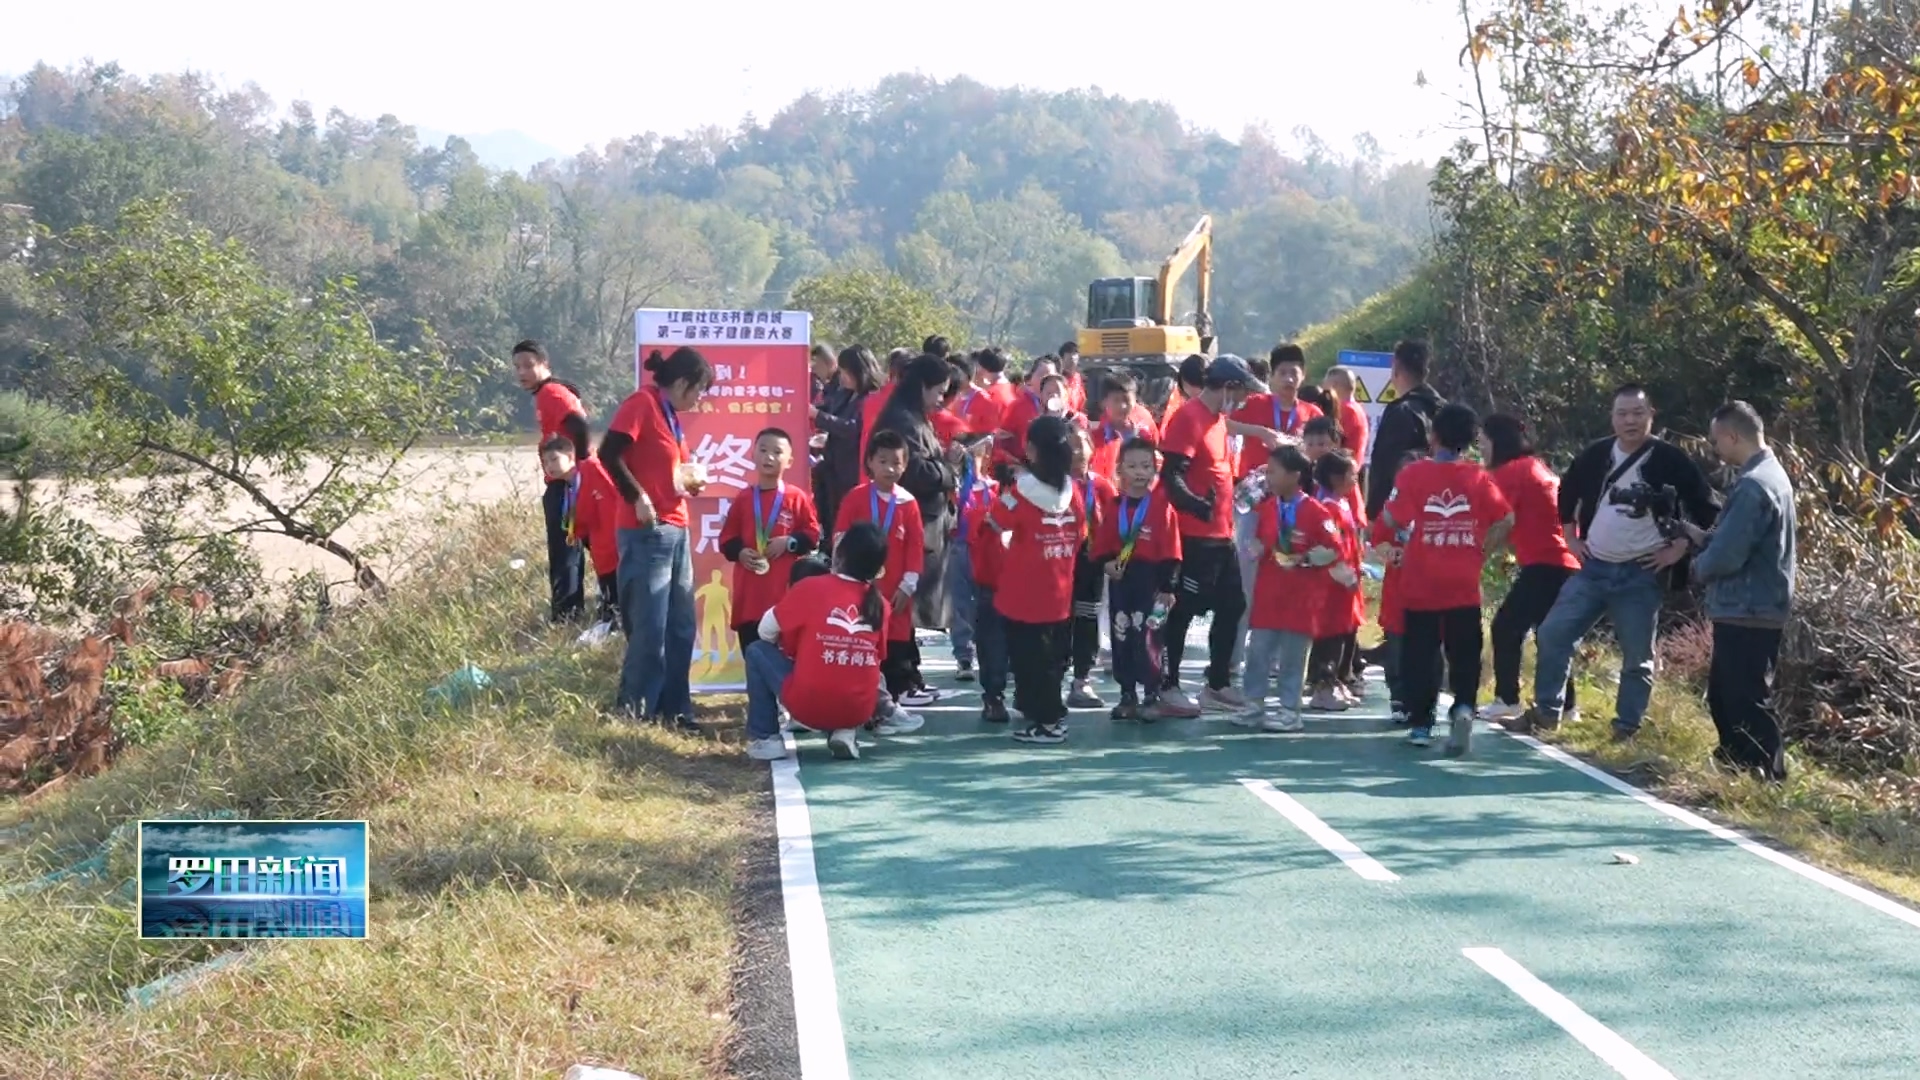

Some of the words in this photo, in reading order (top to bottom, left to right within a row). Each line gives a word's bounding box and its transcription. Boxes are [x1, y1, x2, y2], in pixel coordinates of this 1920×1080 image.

[657, 325, 793, 340] 第一届亲子健康跑大赛
[821, 649, 877, 667] 书香尚城
